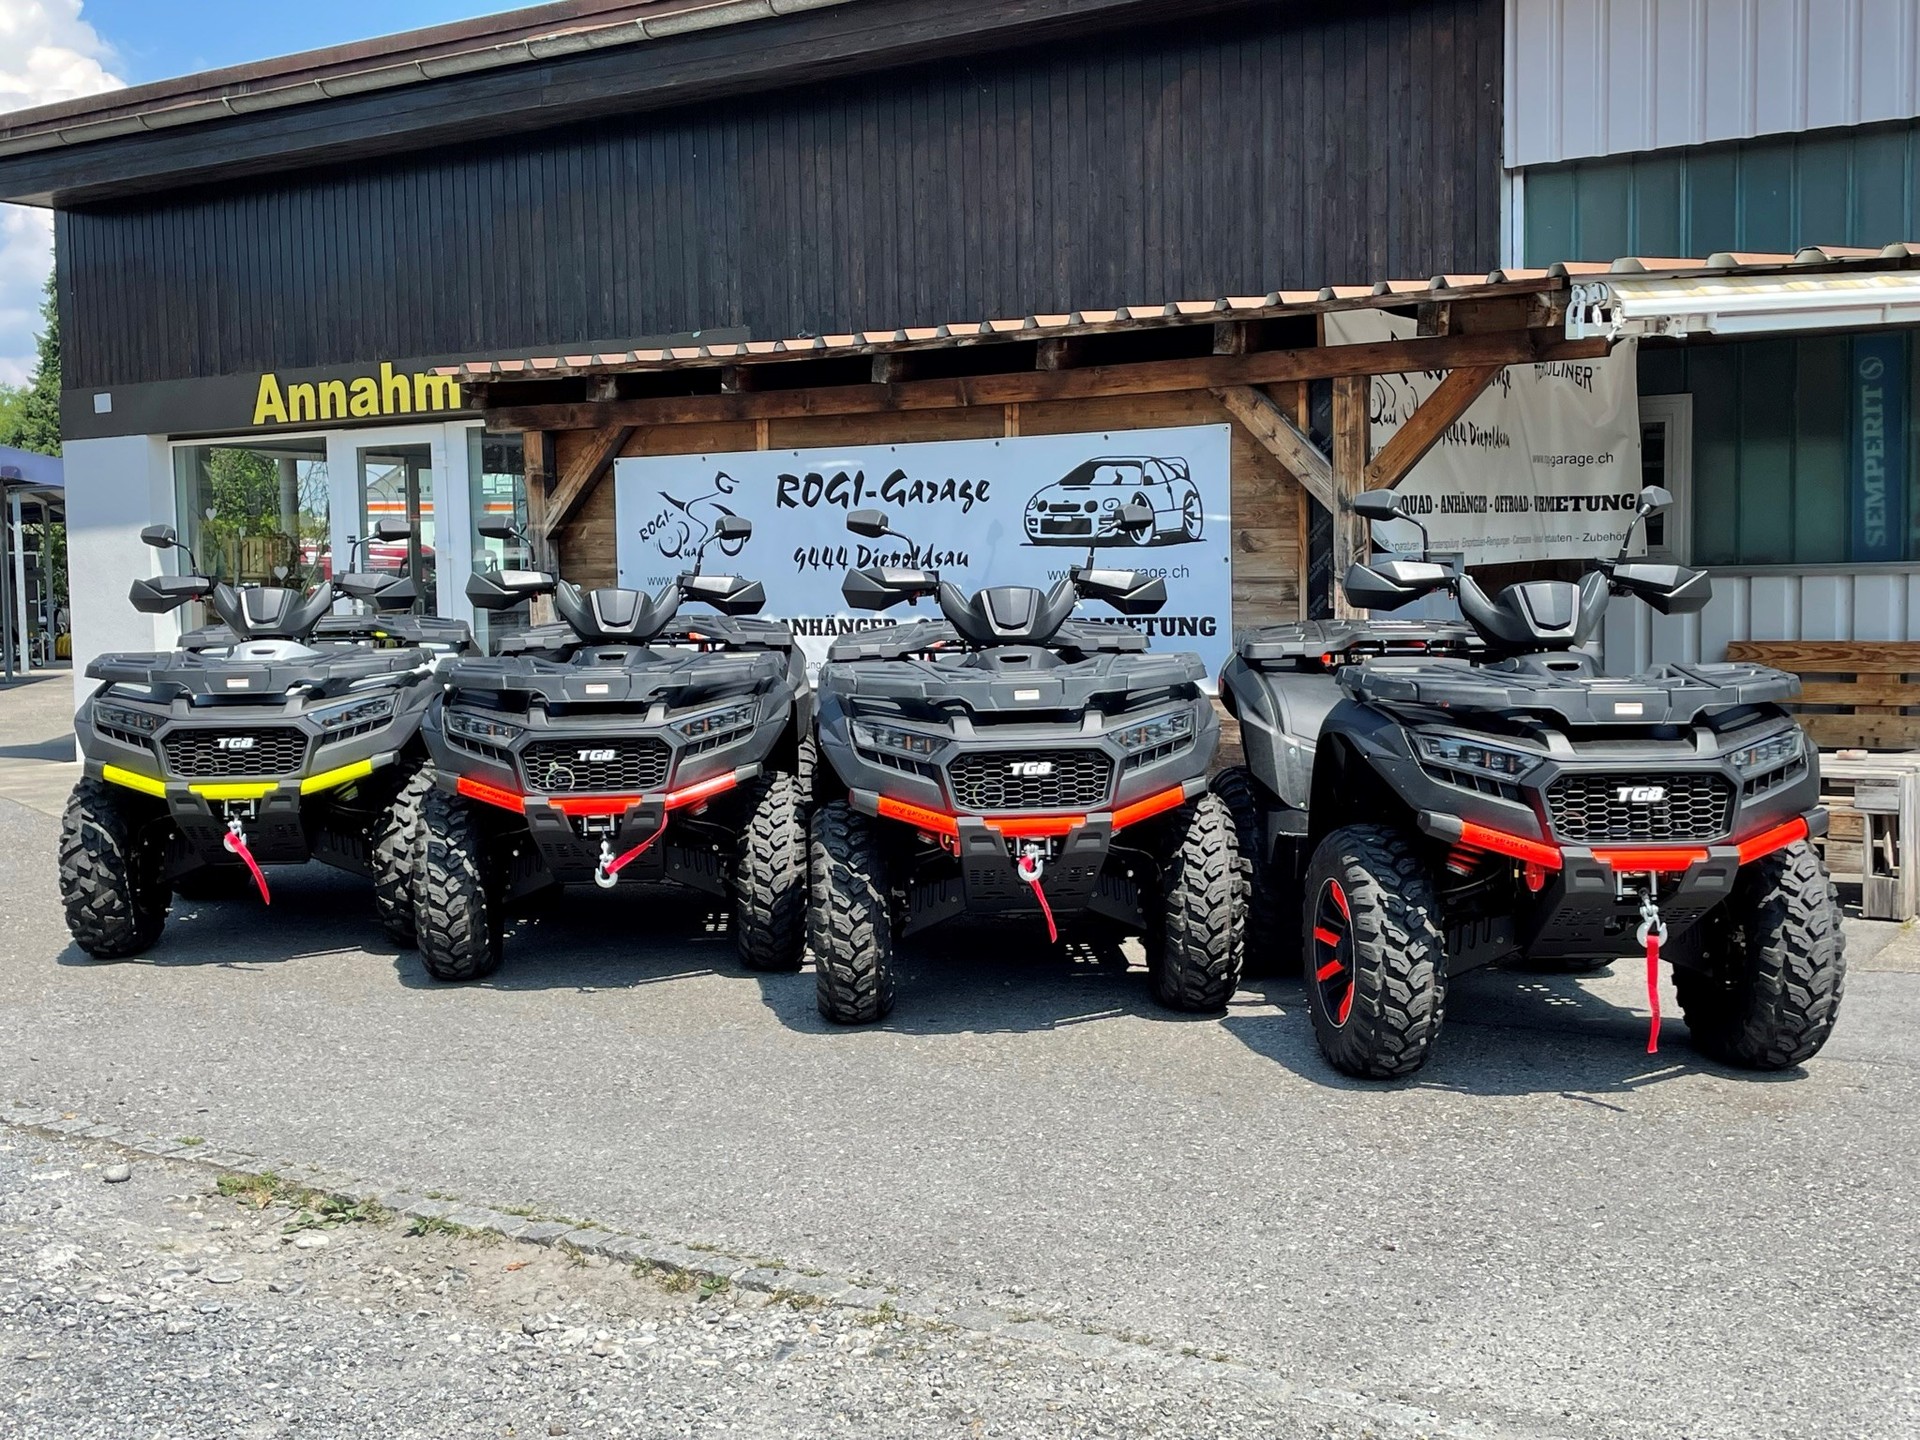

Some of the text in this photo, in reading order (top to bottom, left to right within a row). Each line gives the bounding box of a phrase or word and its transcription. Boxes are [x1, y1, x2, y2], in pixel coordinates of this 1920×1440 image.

[1862, 385, 1887, 547] SEMPERIT
[776, 468, 991, 514] ROGI-Garage
[1401, 495, 1433, 516] QUAD
[1440, 491, 1487, 514] ANHÄNGER
[1494, 495, 1529, 513] OFFROAD
[793, 546, 848, 573] 9444
[217, 737, 254, 748] TGB
[577, 749, 615, 761] TGB
[1010, 761, 1051, 776] TGB
[1616, 786, 1664, 802] TGB
